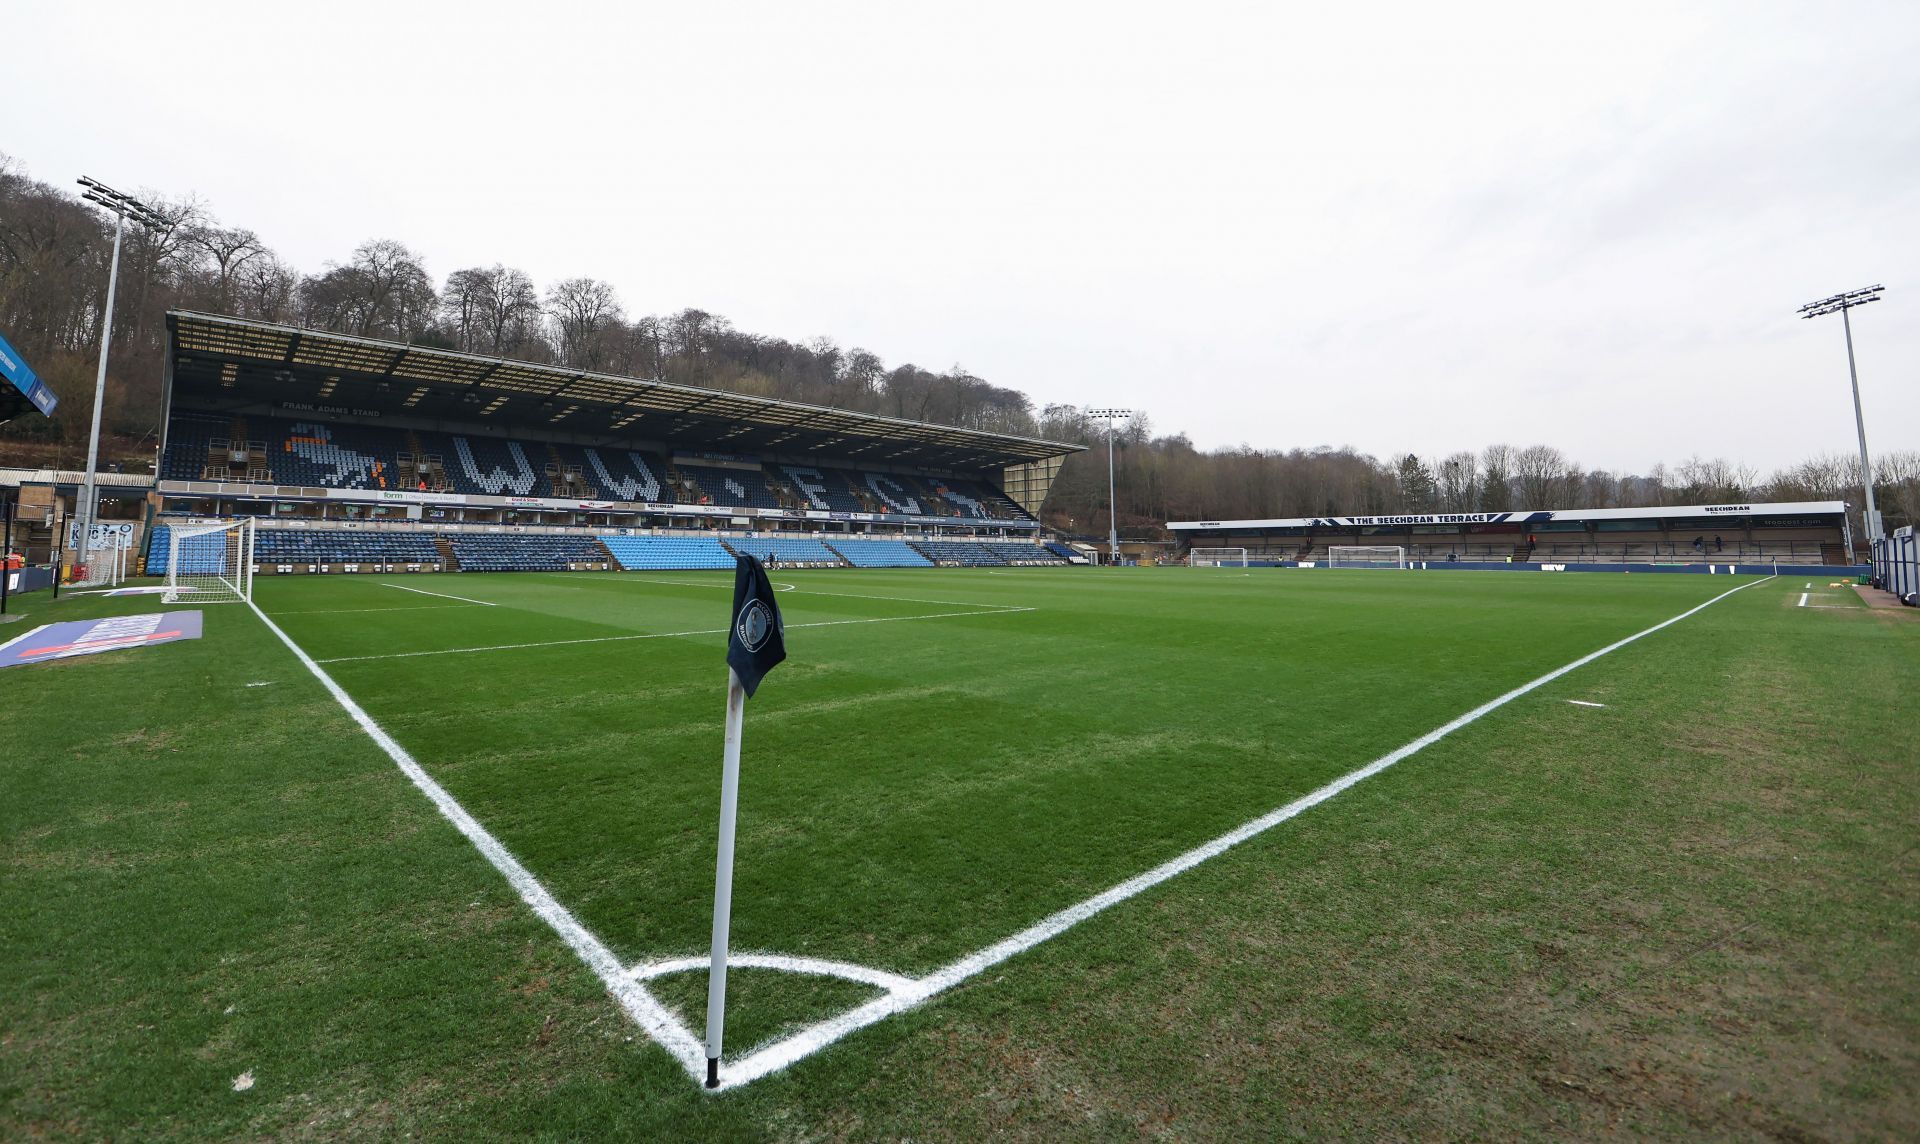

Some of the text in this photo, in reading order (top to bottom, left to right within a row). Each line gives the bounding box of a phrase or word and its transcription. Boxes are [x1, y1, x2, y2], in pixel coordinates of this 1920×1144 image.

[282, 402, 381, 417] FRANK ADAMS STAND
[452, 437, 536, 494] W
[583, 449, 660, 501] W
[1377, 515, 1434, 524] BEECHDEAN
[1438, 514, 1485, 523] TERRACE
